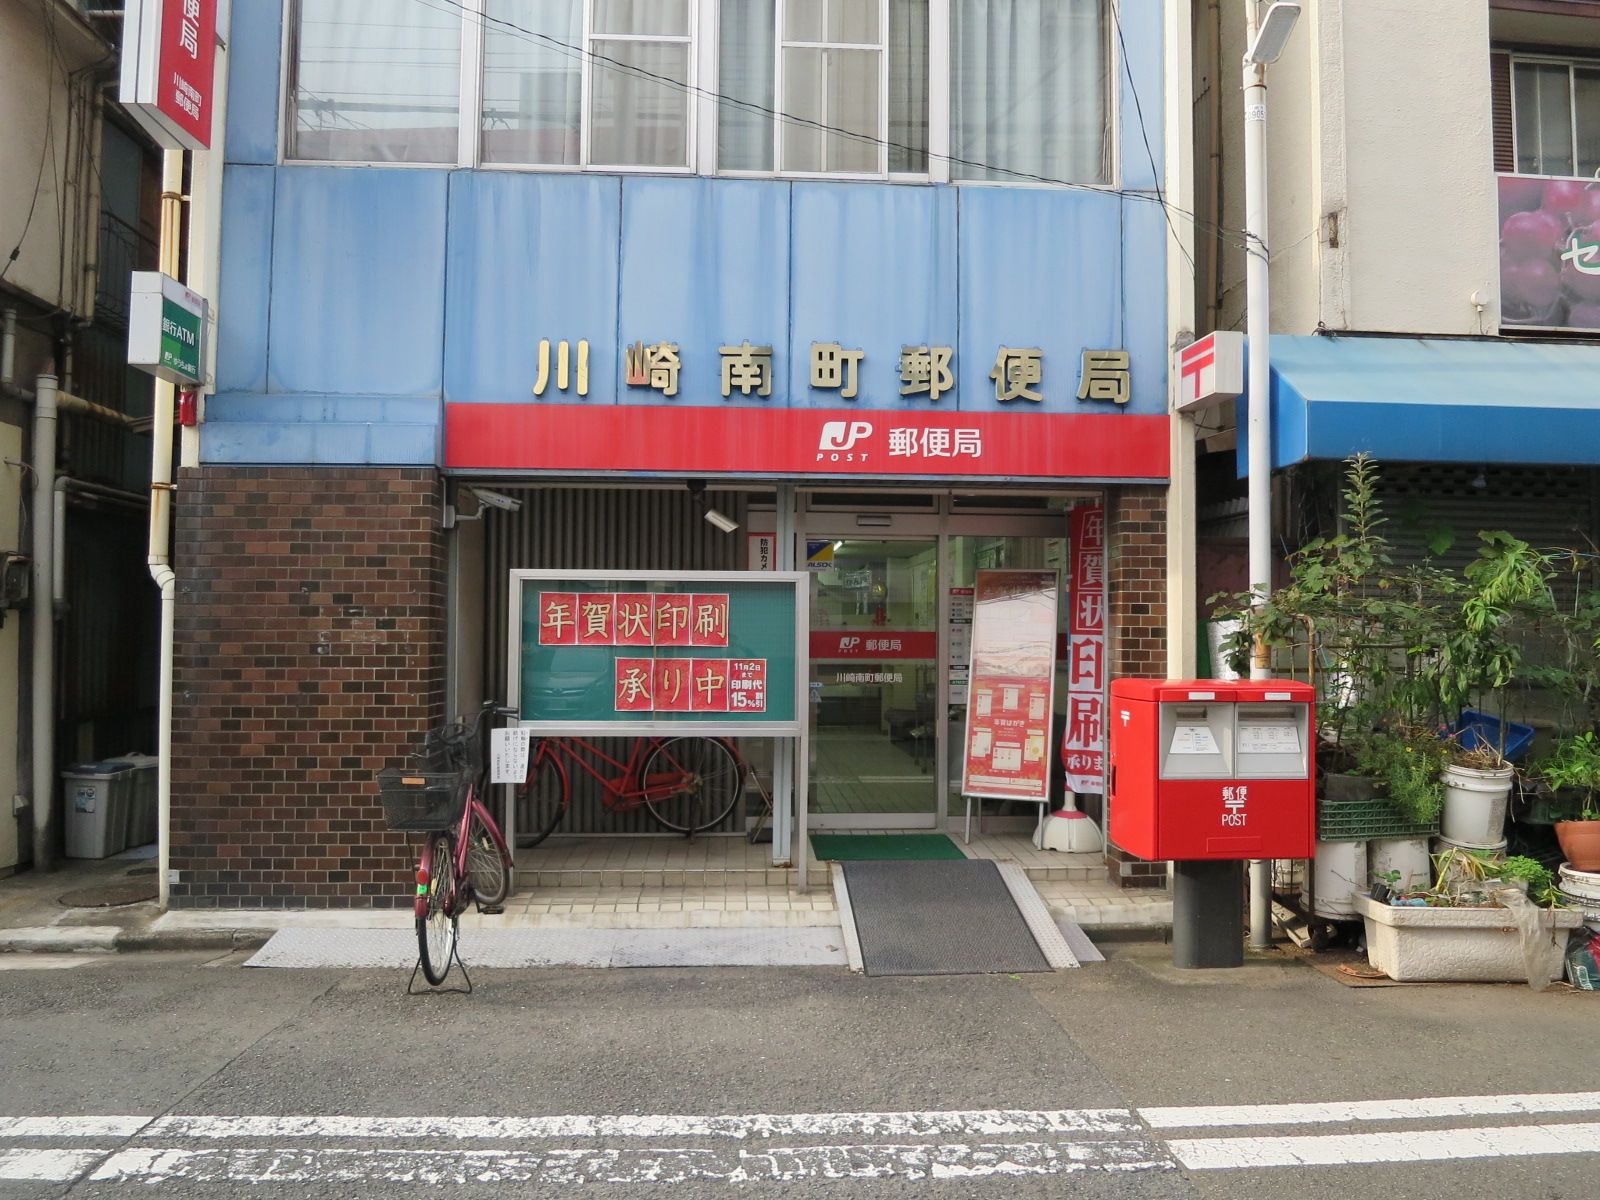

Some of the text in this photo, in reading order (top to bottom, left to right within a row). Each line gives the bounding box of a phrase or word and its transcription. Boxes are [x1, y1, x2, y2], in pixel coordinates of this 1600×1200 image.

[173, 71, 202, 107] 川崎南町
[175, 88, 199, 121] 郵便局
[532, 338, 1131, 404] 川崎南町郵便局
[887, 426, 982, 459] 郵便局
[816, 452, 869, 462] POST
[760, 537, 769, 570] 防犯カメ
[542, 601, 727, 639] 年賀状印刷
[865, 639, 903, 652] 郵便局
[734, 663, 761, 671] 11月2日
[836, 672, 904, 683] 川崎南町郵便局
[618, 667, 725, 704] 承り中
[731, 679, 763, 690] 印刷代
[1221, 786, 1248, 801] 郵便
[1221, 813, 1248, 826] POST
